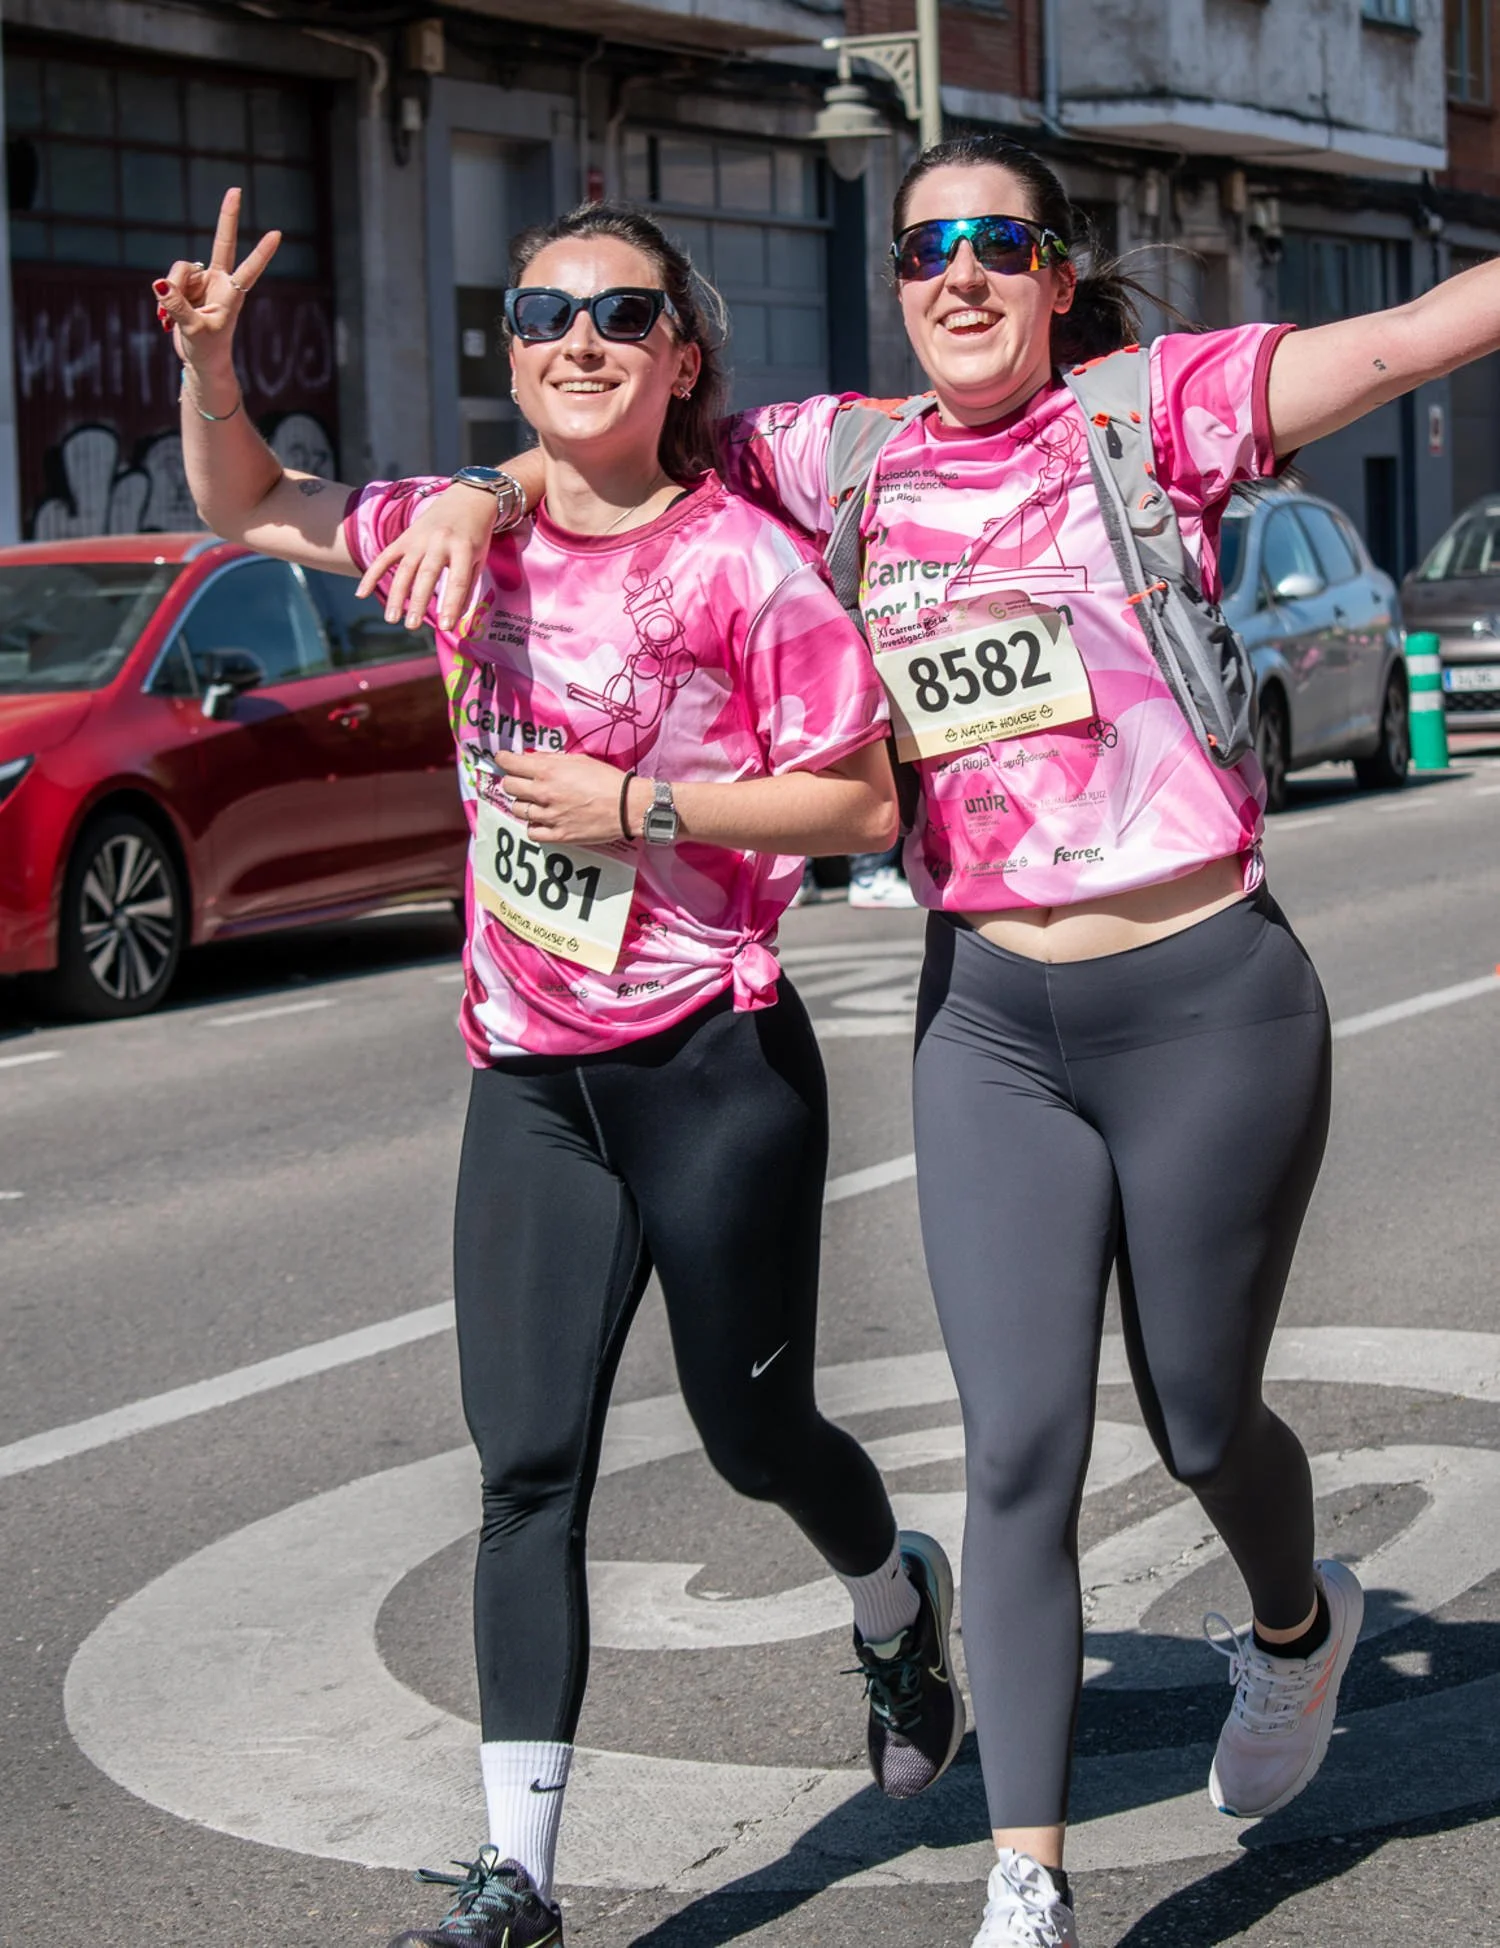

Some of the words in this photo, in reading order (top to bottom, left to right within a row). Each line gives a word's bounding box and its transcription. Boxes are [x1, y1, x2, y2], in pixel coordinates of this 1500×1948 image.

[903, 481, 912, 490] el
[884, 496, 895, 504] La
[897, 493, 922, 504] Rioja
[889, 622, 922, 636] Carrera
[880, 630, 936, 649] investigación
[908, 630, 1052, 713] 8582
[466, 698, 563, 750] Carrera
[1000, 710, 1037, 729] HOUSE
[950, 763, 960, 774] La
[962, 756, 991, 771] Rioja
[1053, 846, 1101, 865] Ferrer
[495, 826, 602, 922] 8581
